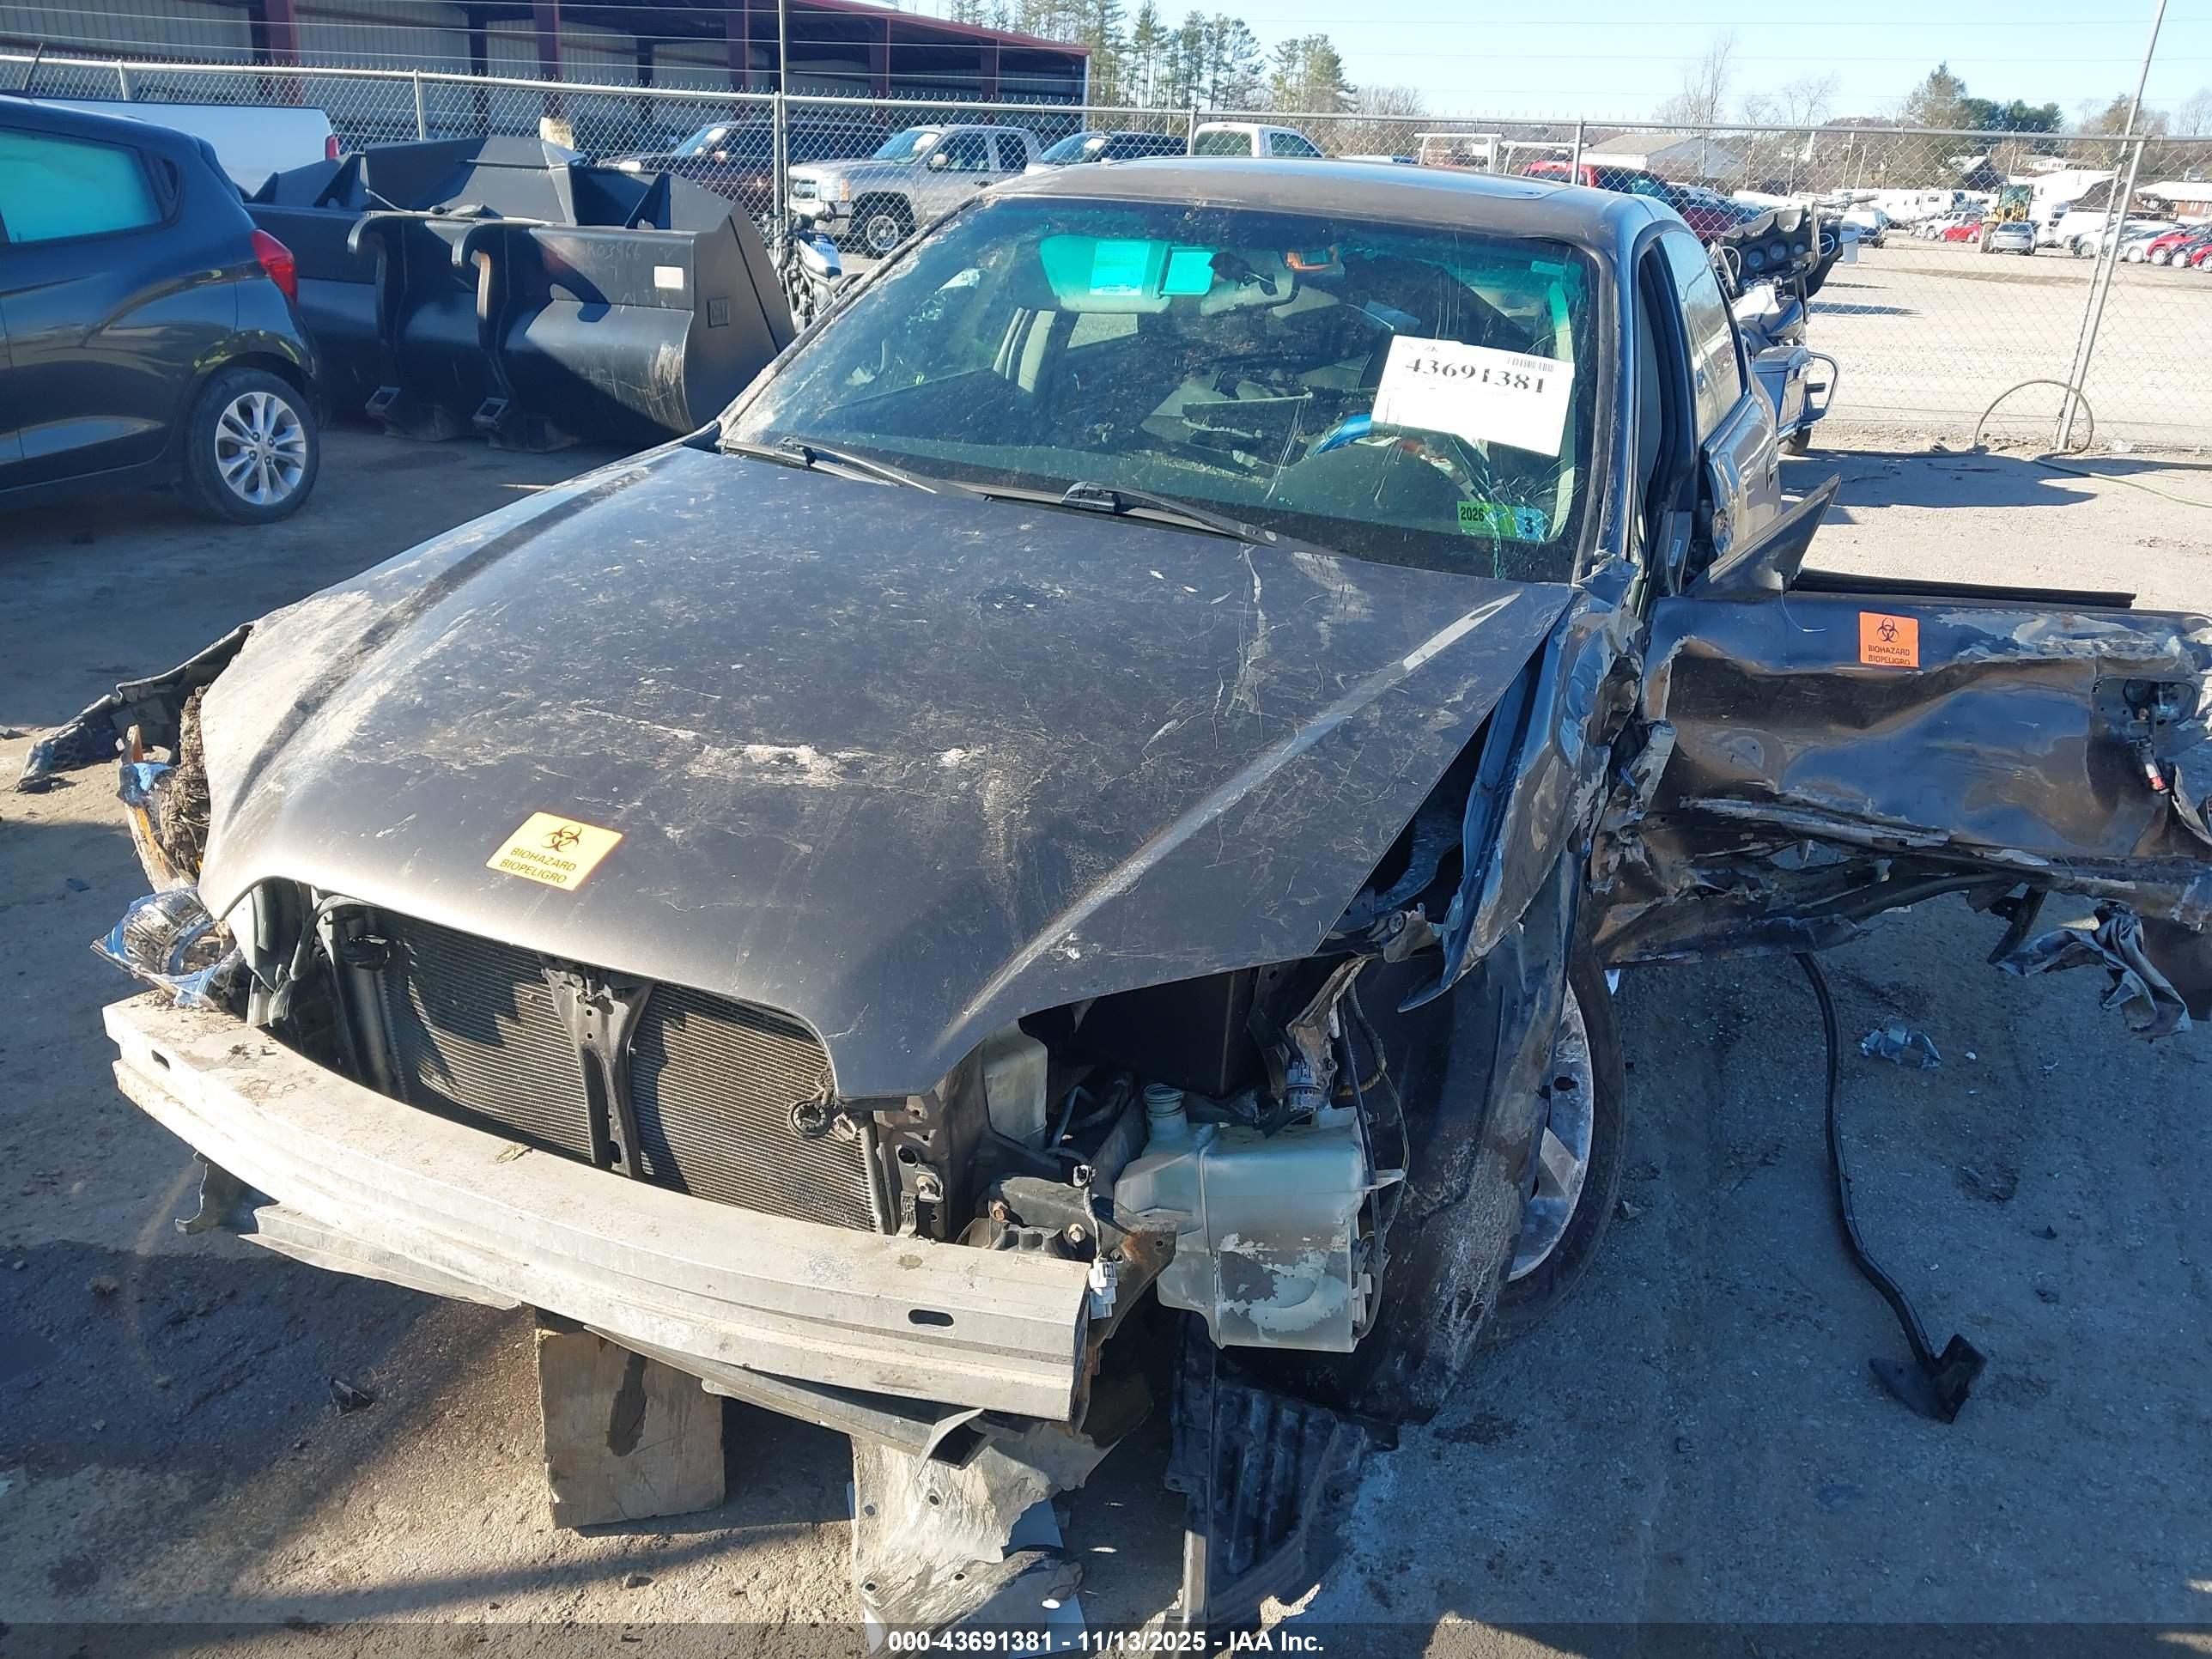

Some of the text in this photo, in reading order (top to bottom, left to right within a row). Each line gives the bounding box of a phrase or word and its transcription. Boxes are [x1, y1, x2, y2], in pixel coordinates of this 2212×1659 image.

[1405, 357, 1545, 393] 43691381
[1460, 506, 1485, 522] 2026
[1524, 516, 1534, 534] 3
[1868, 644, 1911, 656] BIOHAZARD
[1868, 654, 1911, 665] BIOPELIGRO
[510, 848, 577, 872] BIOHAZARD
[499, 859, 568, 884] BIOPELIGRO
